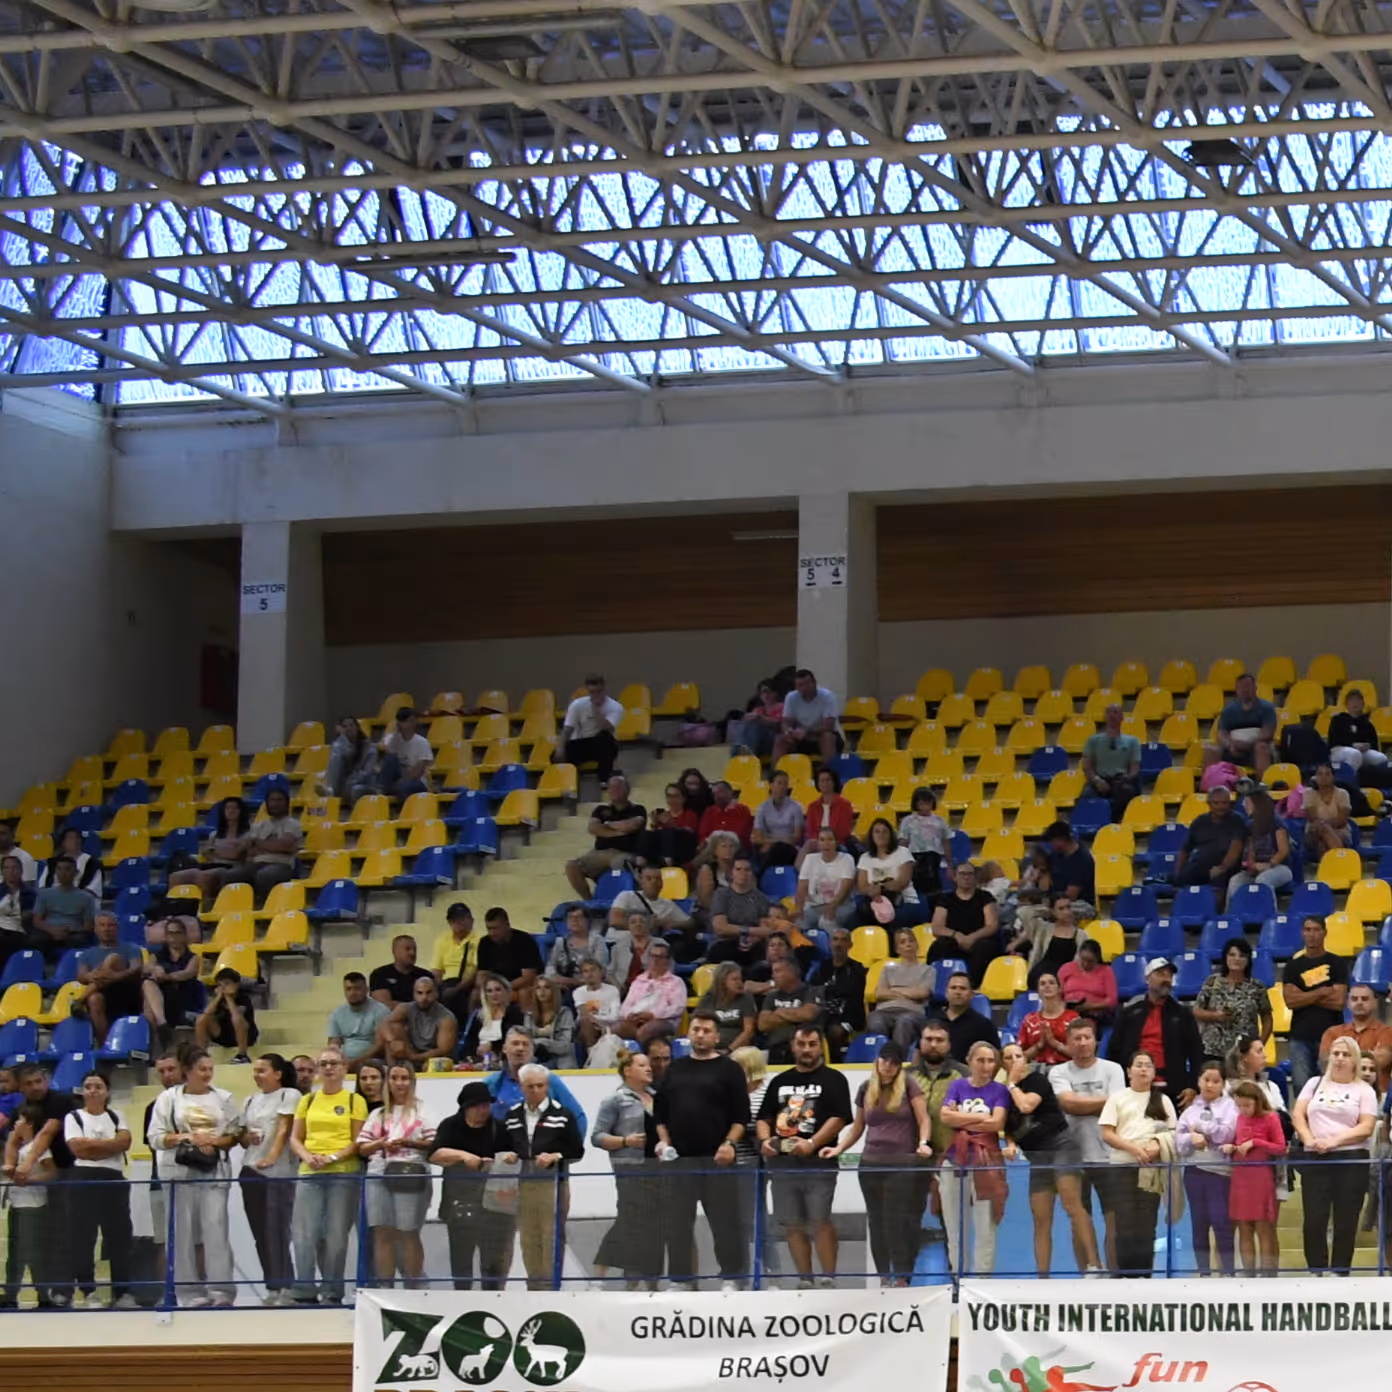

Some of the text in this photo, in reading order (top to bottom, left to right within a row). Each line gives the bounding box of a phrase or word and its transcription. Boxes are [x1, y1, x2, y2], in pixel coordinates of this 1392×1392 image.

[800, 556, 846, 569] SECTOR
[806, 567, 841, 580] 5 4
[243, 583, 285, 596] SECTOR
[259, 598, 270, 611] 5
[631, 1303, 925, 1338] GRĂDINA ZOOLOGICĂ
[968, 1302, 1052, 1332] YOUTH
[1058, 1302, 1254, 1333] INTERNATIONAL
[378, 1309, 586, 1385] ZOO
[718, 1353, 830, 1384] BRAȘOV
[1122, 1352, 1209, 1388] fun
